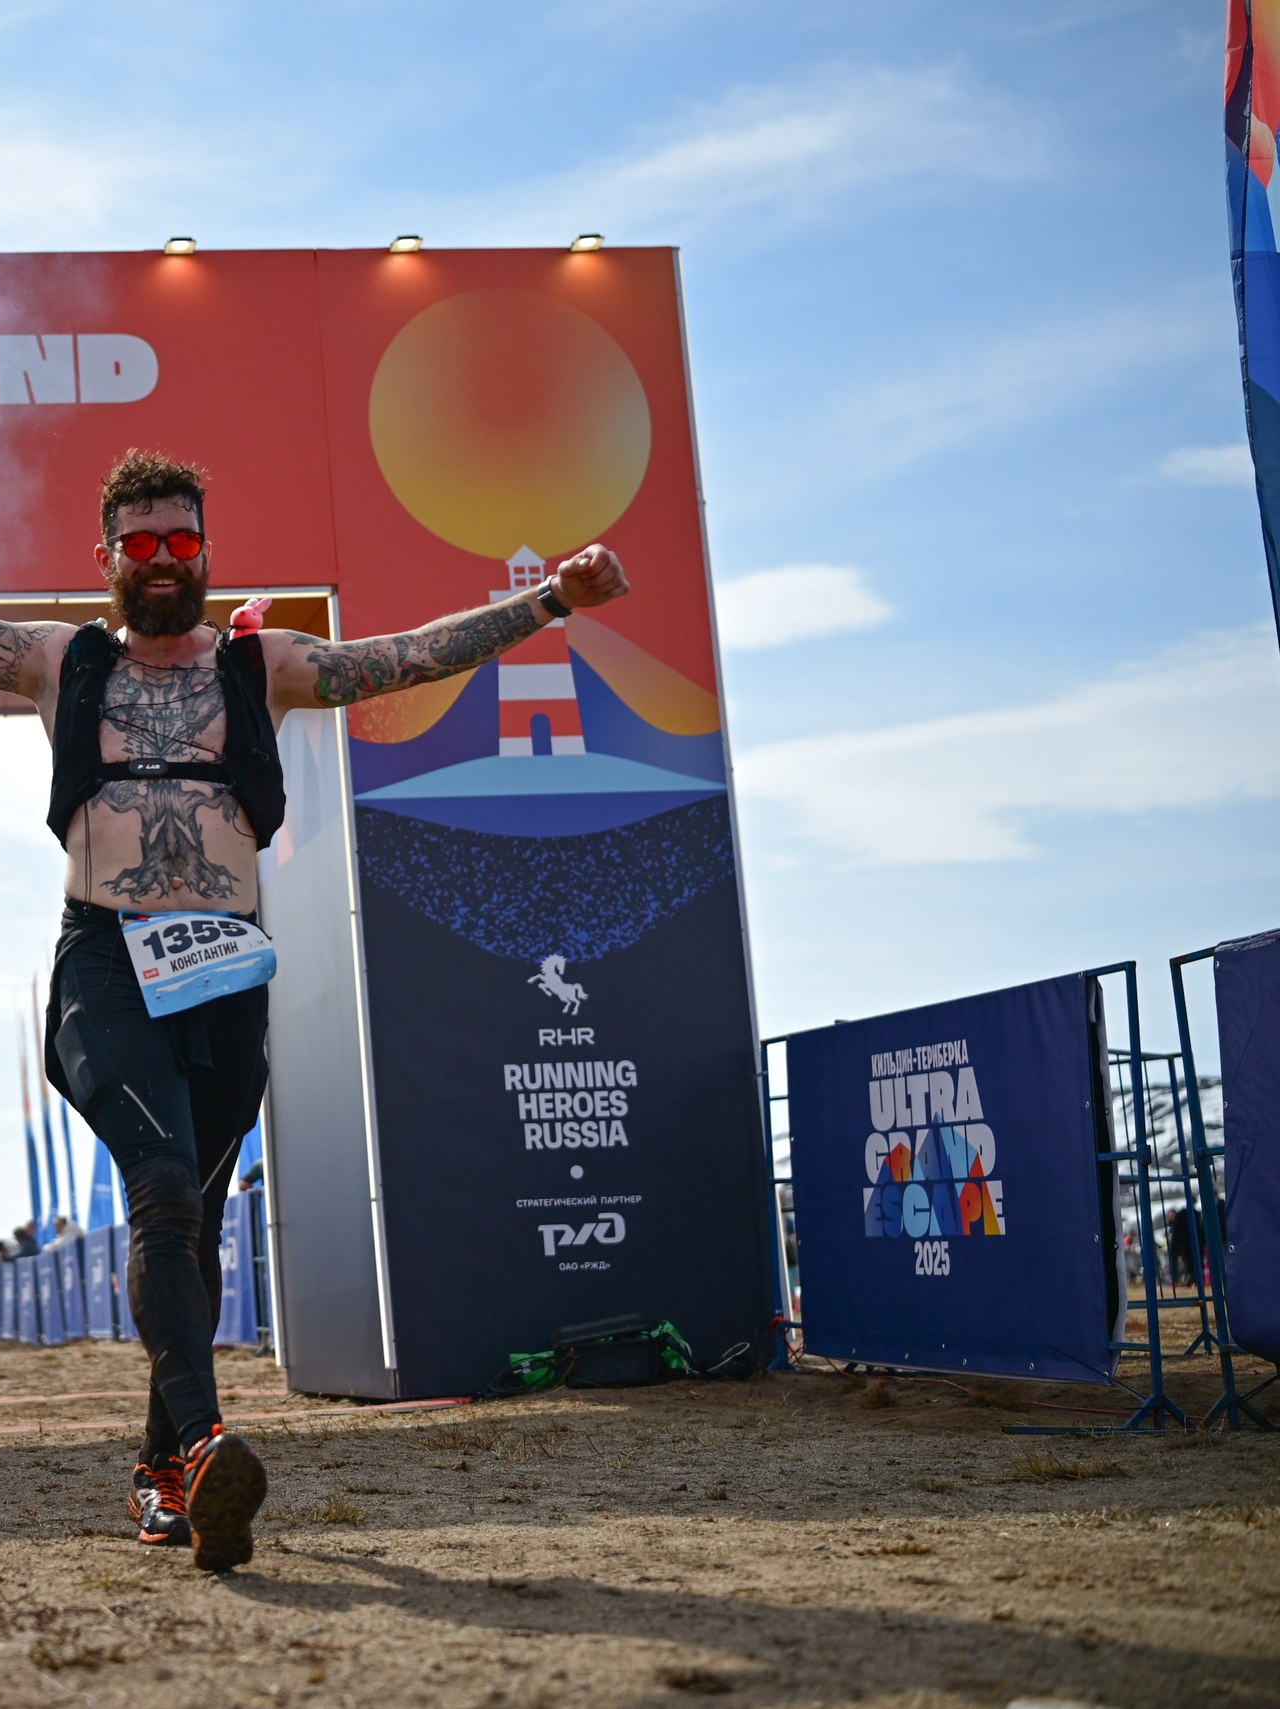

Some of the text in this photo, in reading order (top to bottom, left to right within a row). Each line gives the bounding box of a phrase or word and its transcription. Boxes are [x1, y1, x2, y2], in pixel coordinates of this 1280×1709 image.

[142, 920, 248, 961] 1355
[169, 940, 240, 973] КОНСТАНТИН
[538, 1027, 596, 1047] RHR
[871, 1038, 969, 1079] КИЛЬДИН-ТЕРИБЕРКА
[503, 1059, 638, 1092] RUNNING
[517, 1089, 629, 1121] HEROES
[868, 1066, 984, 1132] ULTRA
[523, 1119, 629, 1150] RUSSIA
[864, 1122, 997, 1186] GRAND
[516, 1195, 642, 1208] СТРАТЕГИЧЕСКИЙ ПАРТНЕР
[862, 1179, 1007, 1239] ESCAPE
[558, 1262, 579, 1271] ОАО
[914, 1240, 951, 1277] 2025
